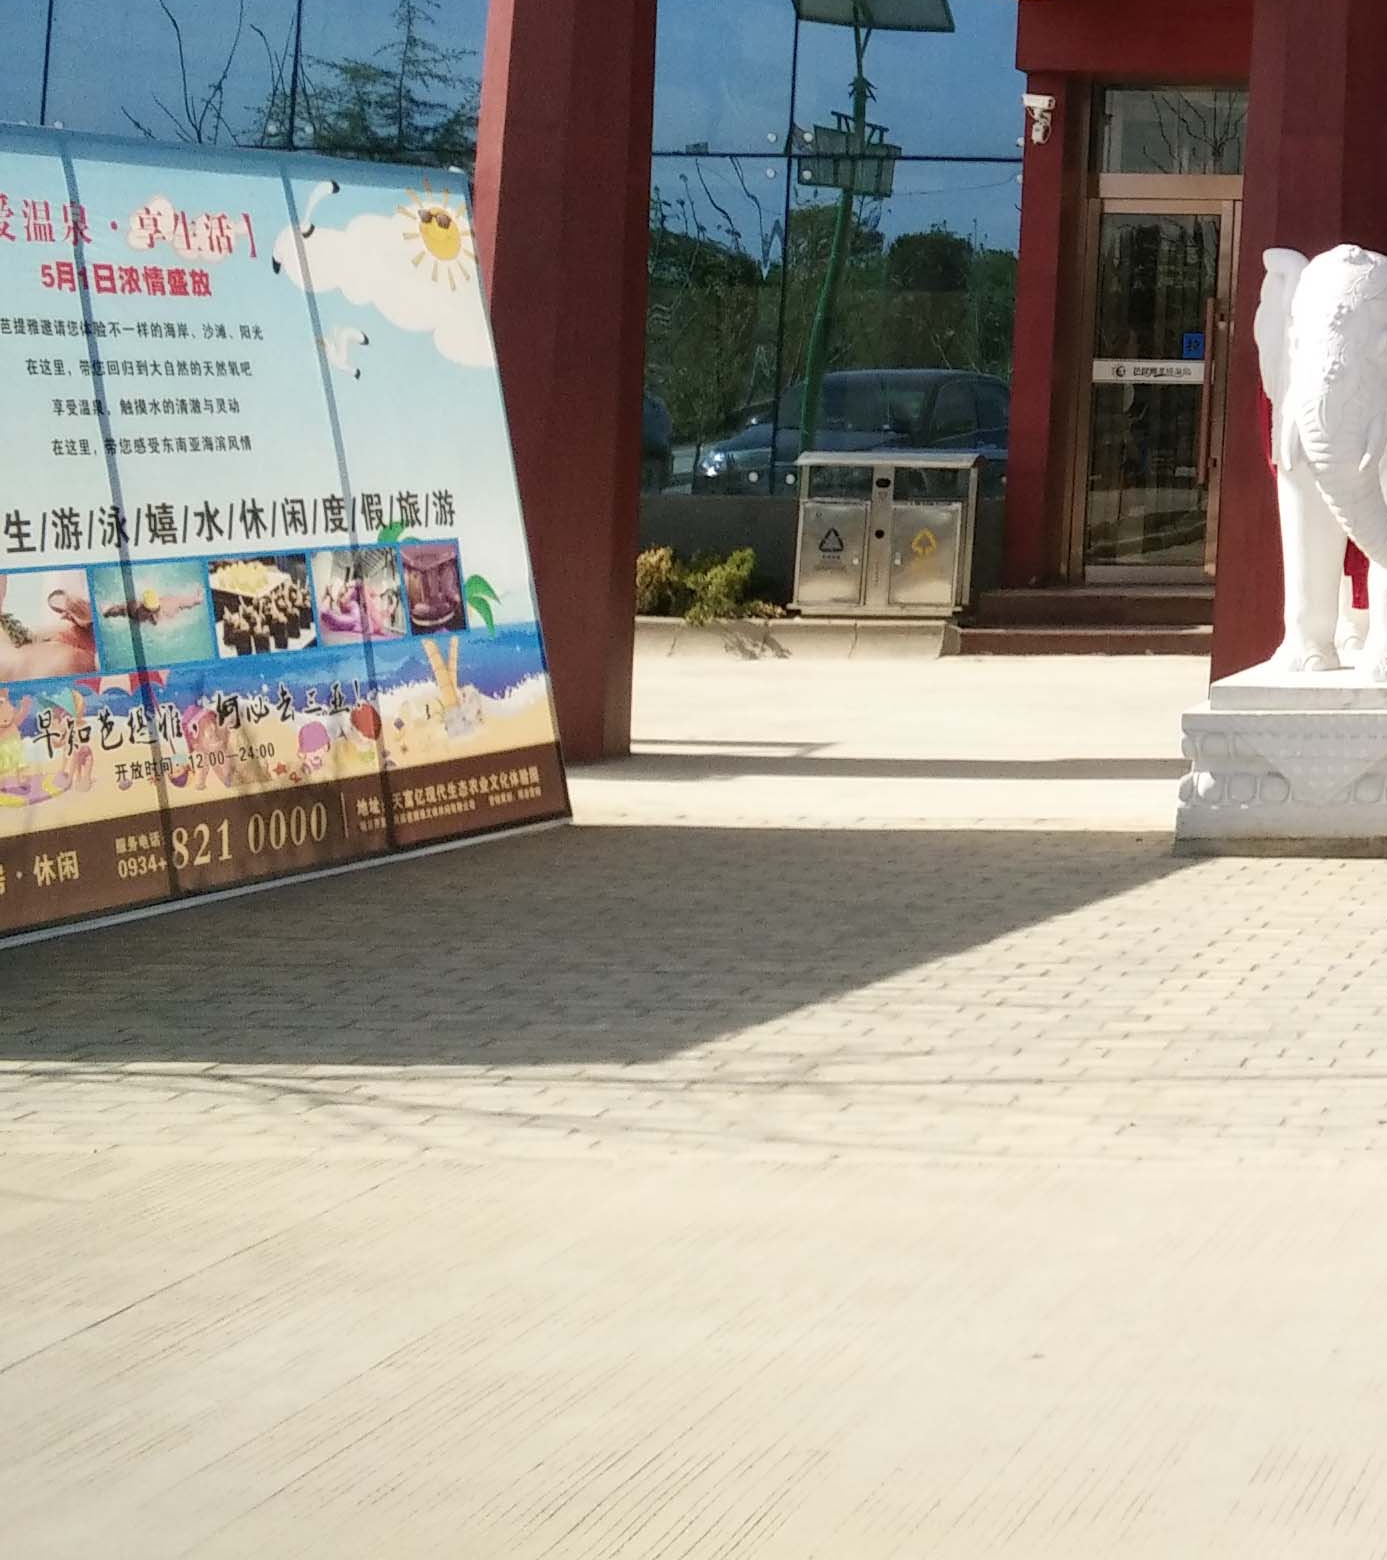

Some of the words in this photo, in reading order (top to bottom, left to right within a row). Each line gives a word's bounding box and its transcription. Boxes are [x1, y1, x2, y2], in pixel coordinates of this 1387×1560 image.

[41, 261, 213, 297] 5月1日浓情盛放
[171, 818, 233, 870] 821
[247, 802, 328, 854] 0000
